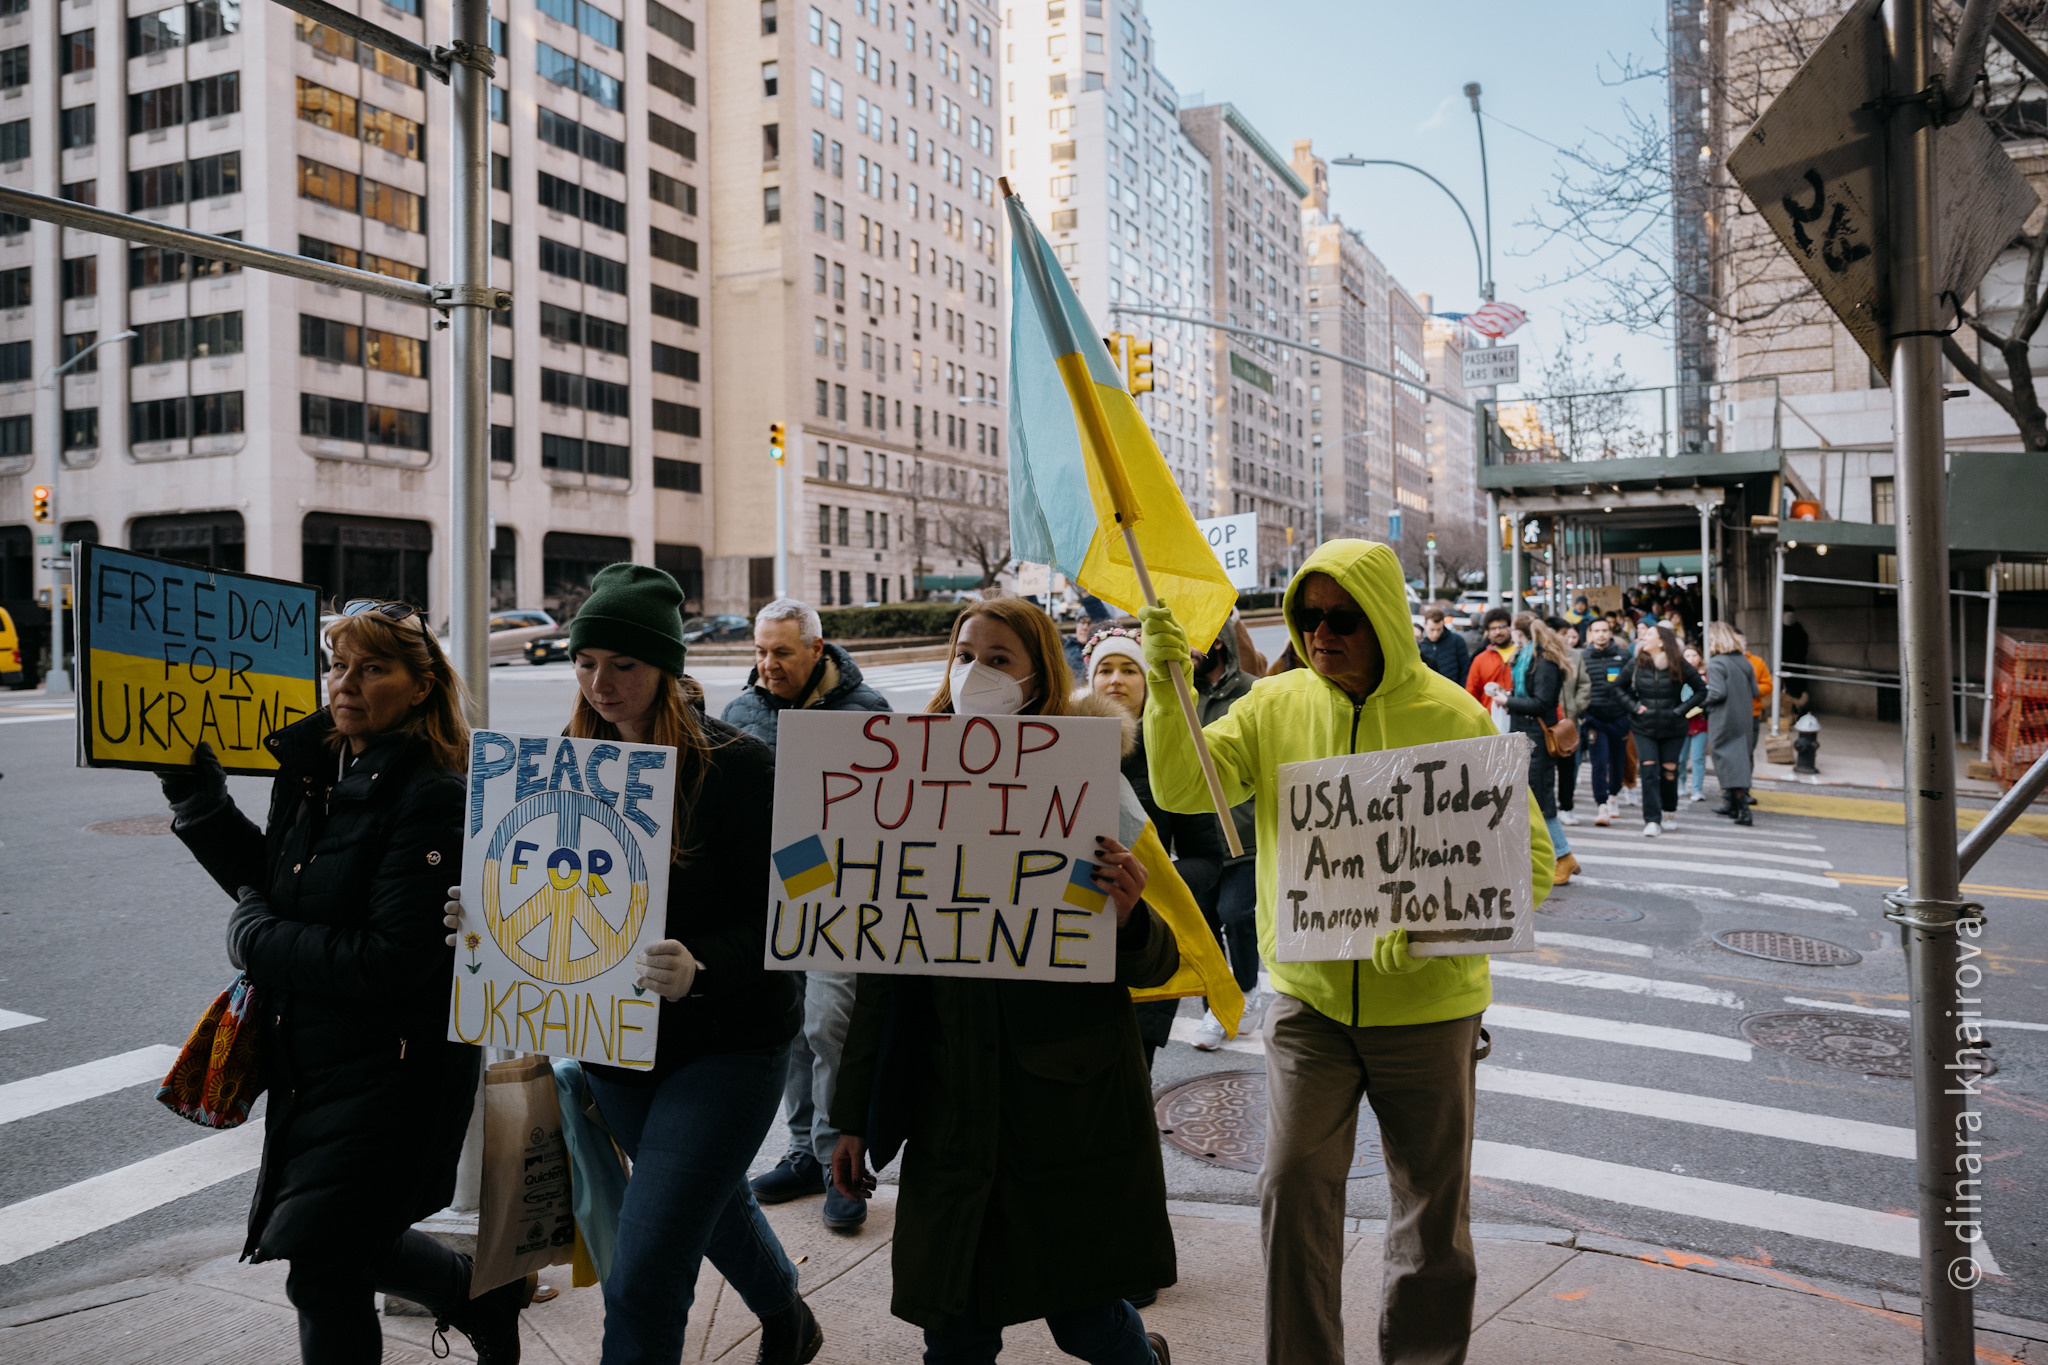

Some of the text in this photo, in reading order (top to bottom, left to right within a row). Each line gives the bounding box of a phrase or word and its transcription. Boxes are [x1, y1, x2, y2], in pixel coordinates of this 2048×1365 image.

[1464, 350, 1515, 366] PASSENGER
[1465, 366, 1515, 381] CARS ONLY
[97, 564, 308, 656] FREEDOM
[164, 643, 254, 694] FOR
[849, 715, 1060, 778] STOP
[471, 731, 667, 839] PEACE
[822, 770, 1089, 838] PUTIN
[1412, 760, 1513, 830] Today
[510, 840, 613, 897] FOR
[831, 837, 1068, 905] HELP
[1304, 825, 1482, 880] Arm Ukraine
[771, 900, 1092, 969] UKRAINE
[1287, 890, 1380, 932] Tomorrow
[455, 975, 655, 1065] UKRAINE
